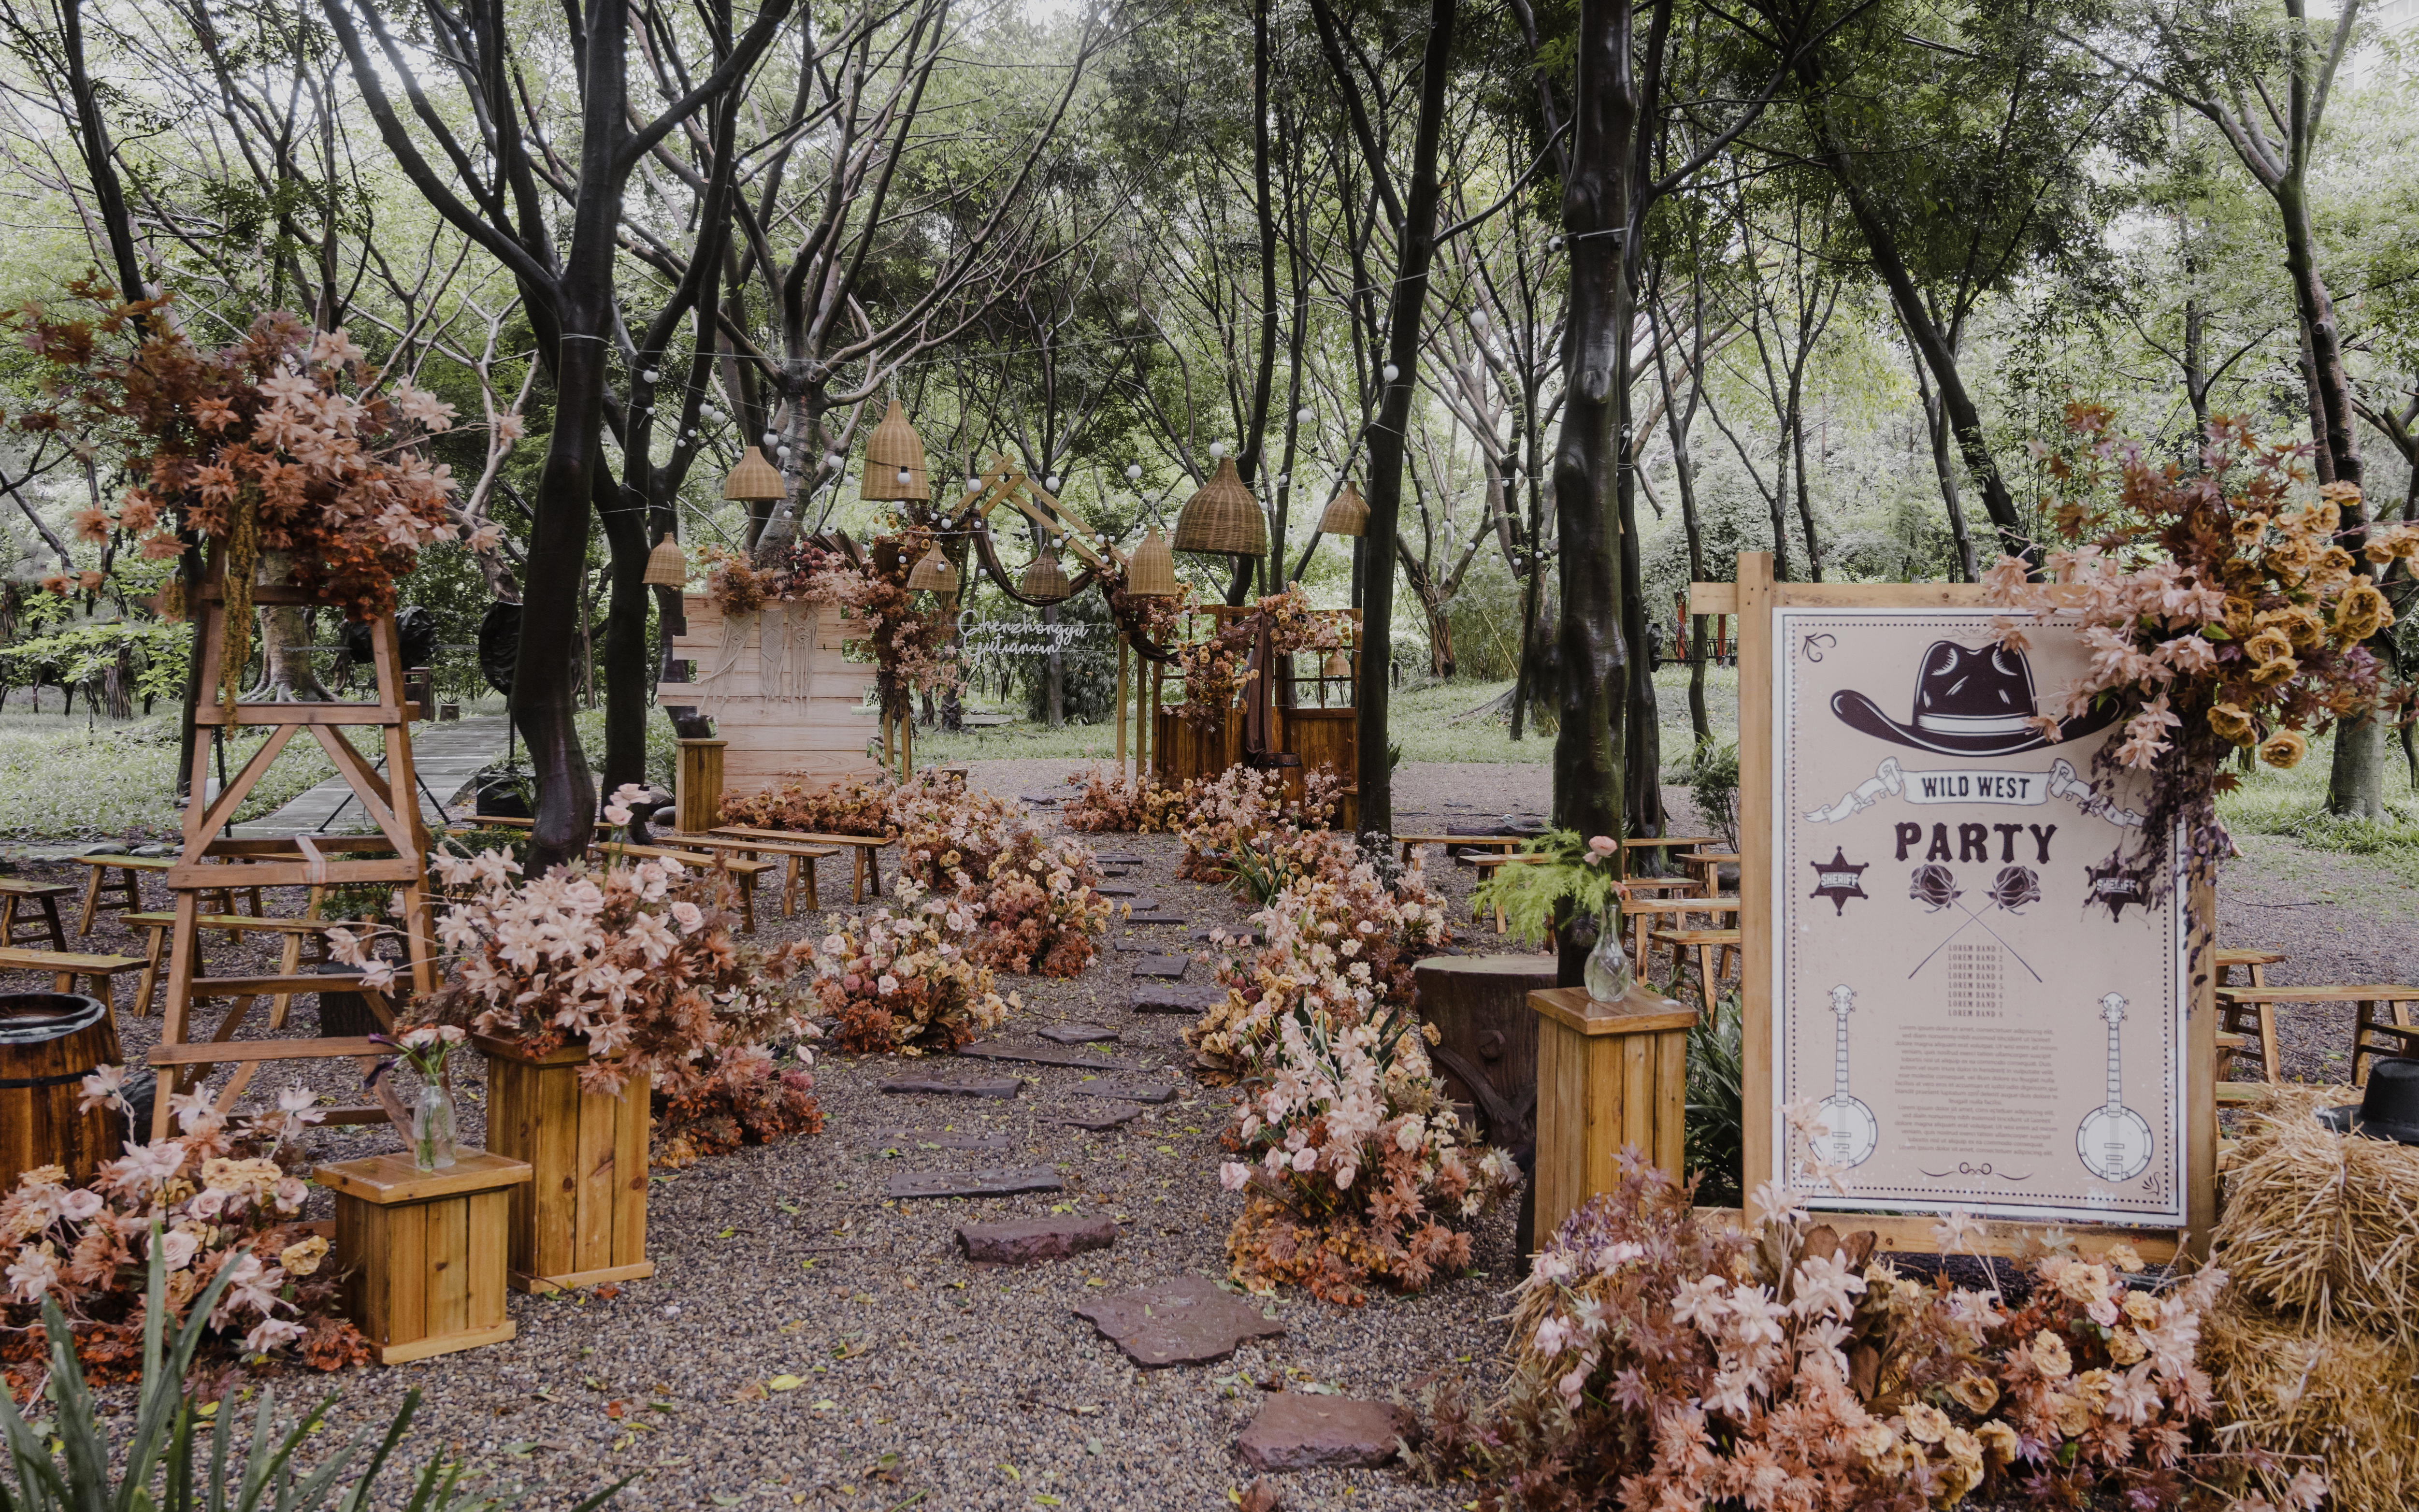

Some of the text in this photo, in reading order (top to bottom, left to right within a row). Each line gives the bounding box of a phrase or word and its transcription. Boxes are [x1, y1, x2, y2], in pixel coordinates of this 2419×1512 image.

[1922, 776, 2030, 799] WILD WEST
[1893, 822, 2058, 864] PARTY
[1821, 873, 1858, 887] SHERIFF
